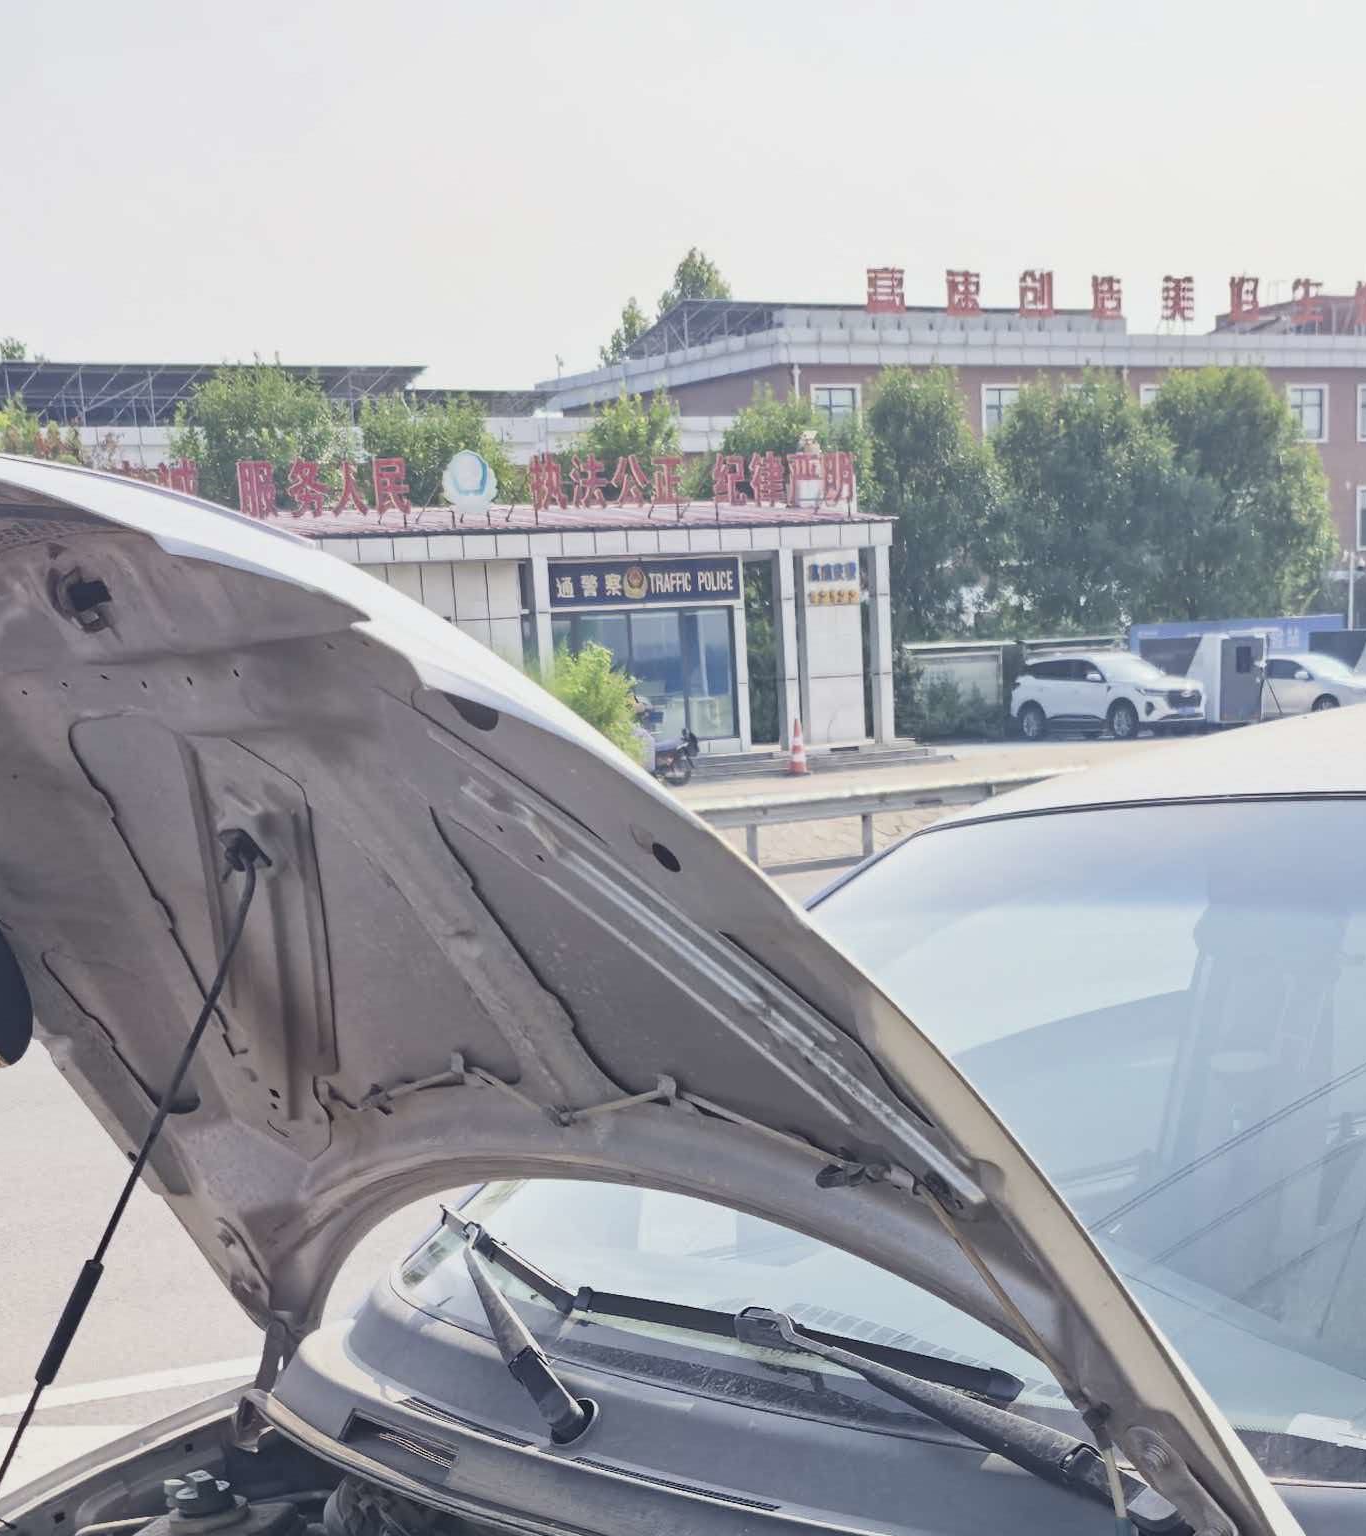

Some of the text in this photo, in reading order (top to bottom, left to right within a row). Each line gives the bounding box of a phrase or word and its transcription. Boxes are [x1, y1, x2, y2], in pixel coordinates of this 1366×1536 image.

[237, 454, 412, 519] 服务人民
[529, 451, 685, 511] 执法公正
[713, 450, 857, 508] 纪律严明
[648, 570, 734, 595] TRAFFIC POLICE
